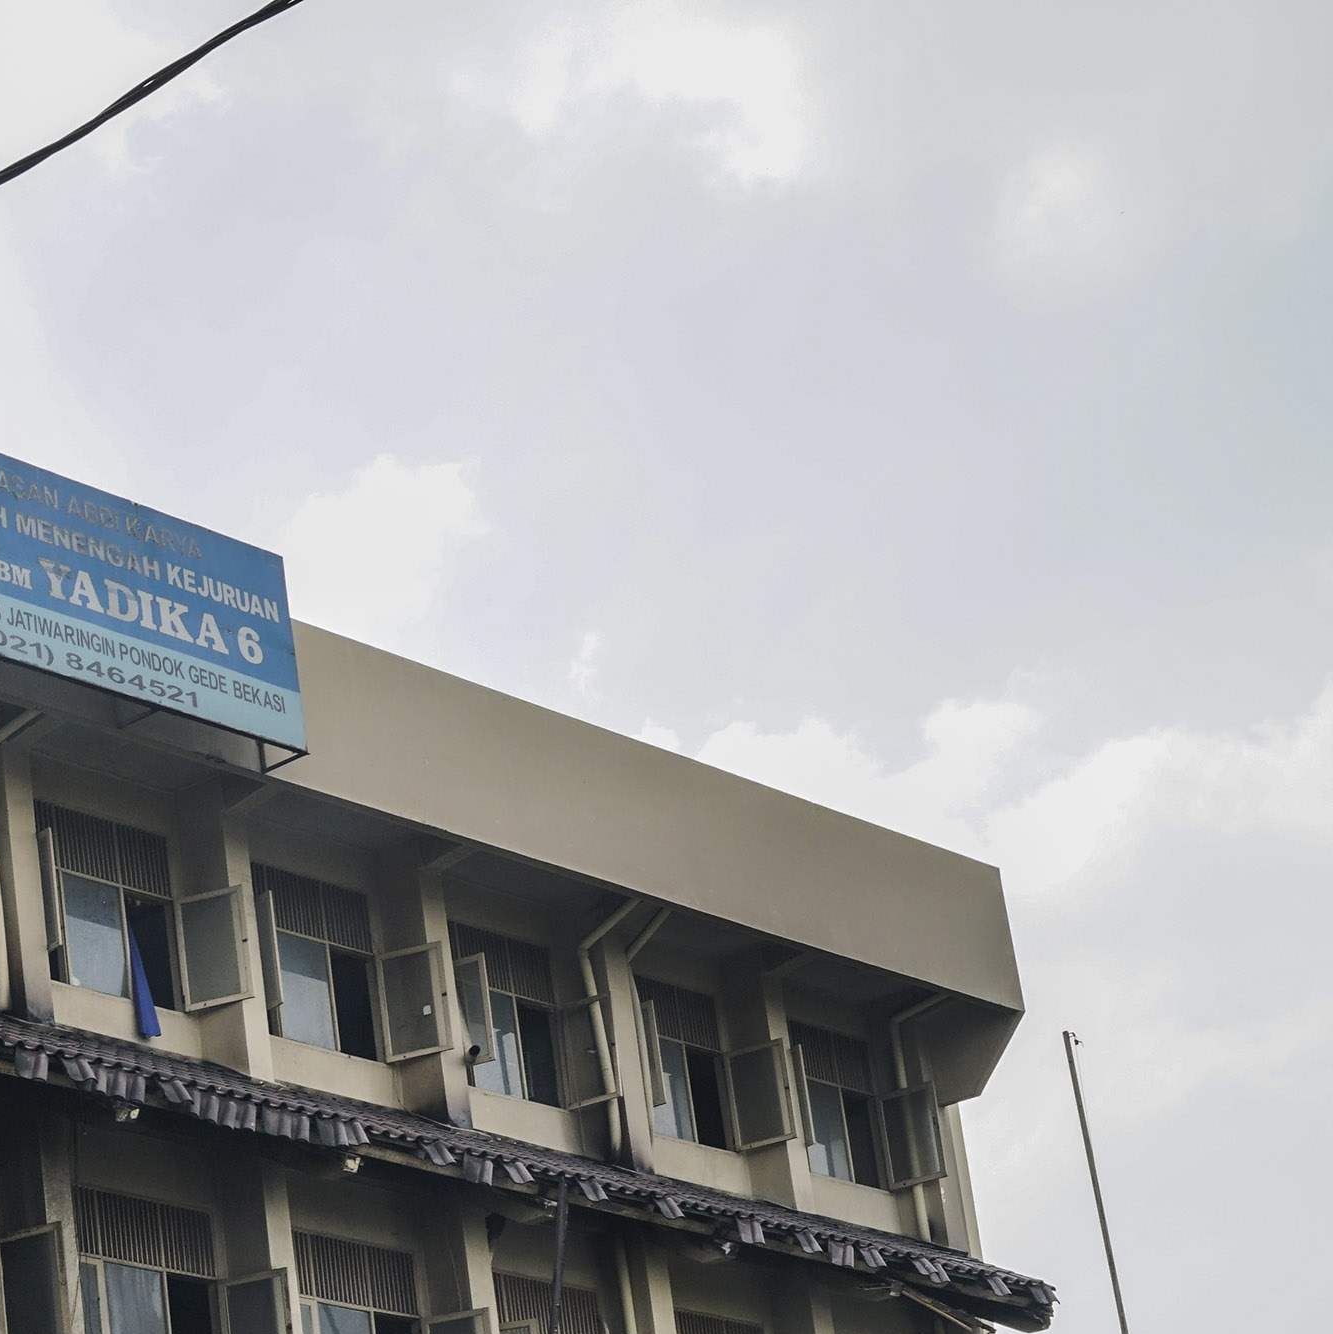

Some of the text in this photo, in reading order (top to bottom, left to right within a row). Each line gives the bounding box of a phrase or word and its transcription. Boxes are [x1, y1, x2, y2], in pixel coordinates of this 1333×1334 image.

[15, 512, 161, 581] MENENGAH
[166, 562, 281, 624] KEJURUAN
[67, 495, 121, 533] ABDI
[125, 517, 203, 561] KARYA
[6, 607, 116, 659] JATIWARINGIN
[120, 643, 185, 680] PONDOK
[188, 665, 228, 695] GEDE
[233, 679, 286, 714] BEKASI
[37, 556, 229, 656] YADIKA
[237, 626, 264, 665] 6
[66, 652, 199, 708] 8464521
